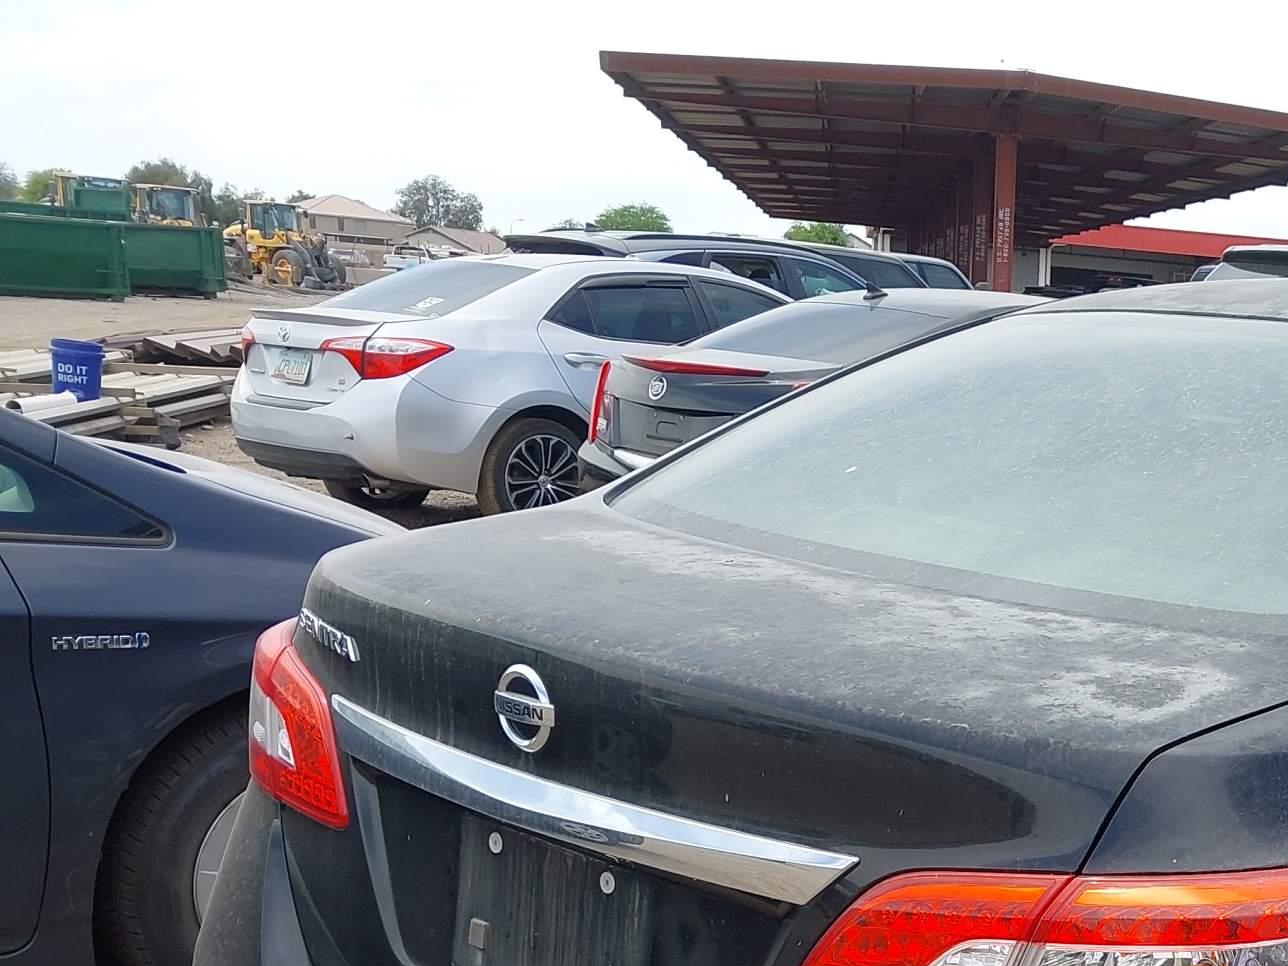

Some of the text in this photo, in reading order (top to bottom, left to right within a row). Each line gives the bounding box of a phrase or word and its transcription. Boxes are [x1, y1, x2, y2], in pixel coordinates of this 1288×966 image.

[57, 362, 88, 376] DO IT
[57, 373, 88, 385] RIGHT
[51, 634, 135, 650] HYBRID
[300, 608, 360, 662] SENTRA
